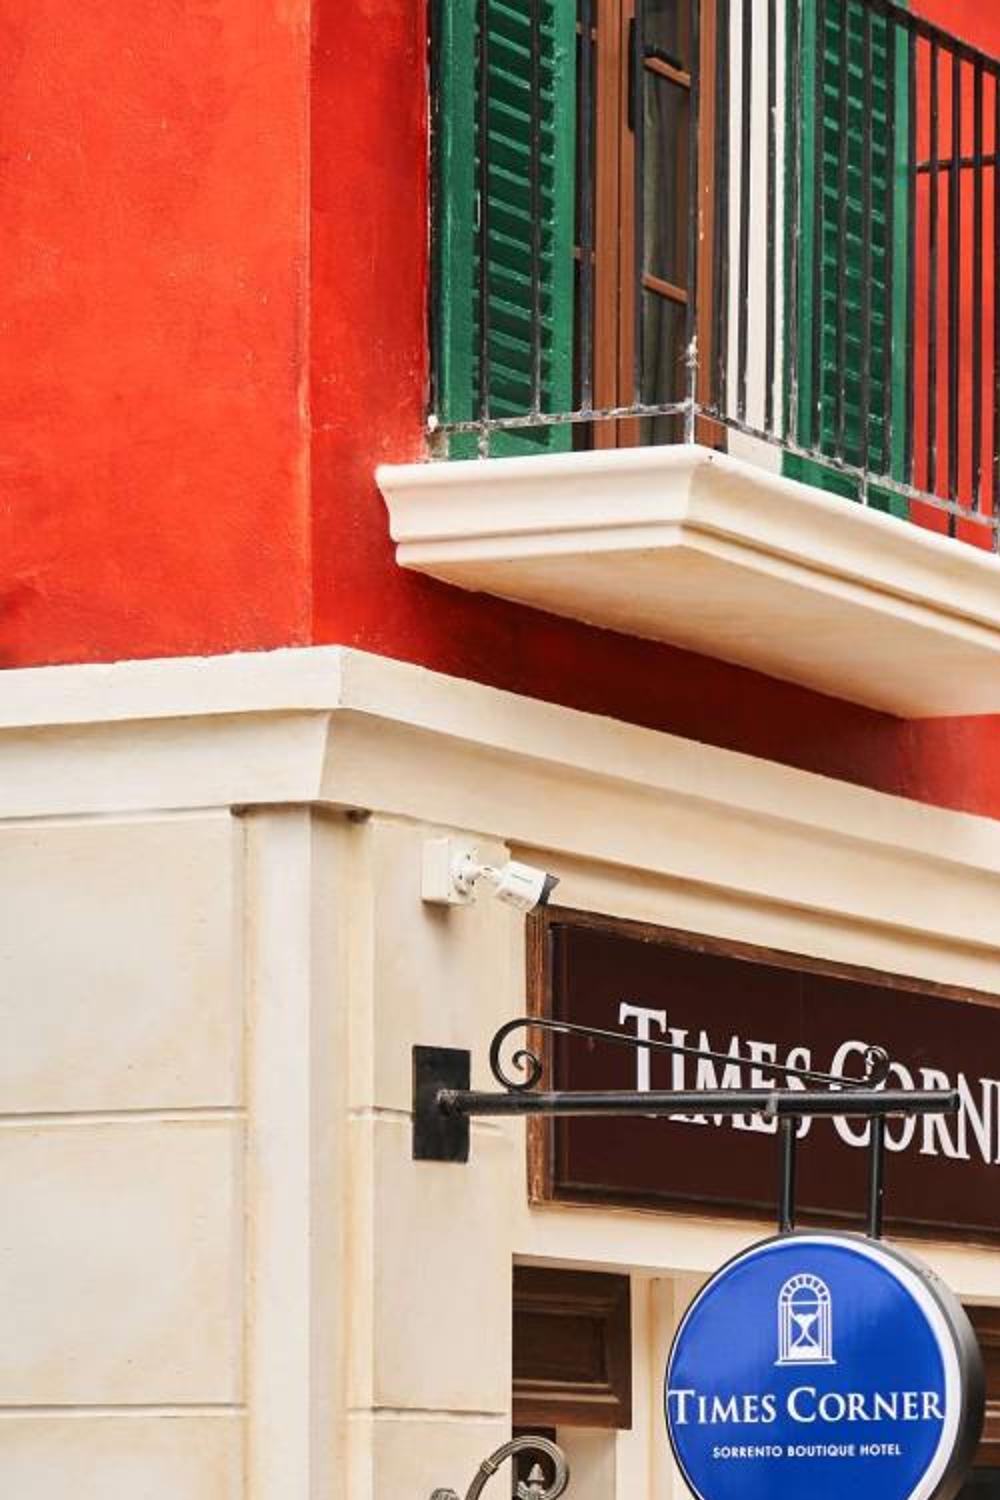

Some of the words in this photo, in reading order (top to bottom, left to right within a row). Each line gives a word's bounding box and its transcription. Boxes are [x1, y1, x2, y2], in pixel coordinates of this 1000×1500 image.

[619, 1002, 811, 1139] TIMES
[667, 1389, 777, 1425] TIMES
[787, 1386, 945, 1423] CORNER
[713, 1445, 783, 1459] SORRENTO
[787, 1444, 855, 1457] BOUTIQUE
[860, 1443, 901, 1456] HOTEL
